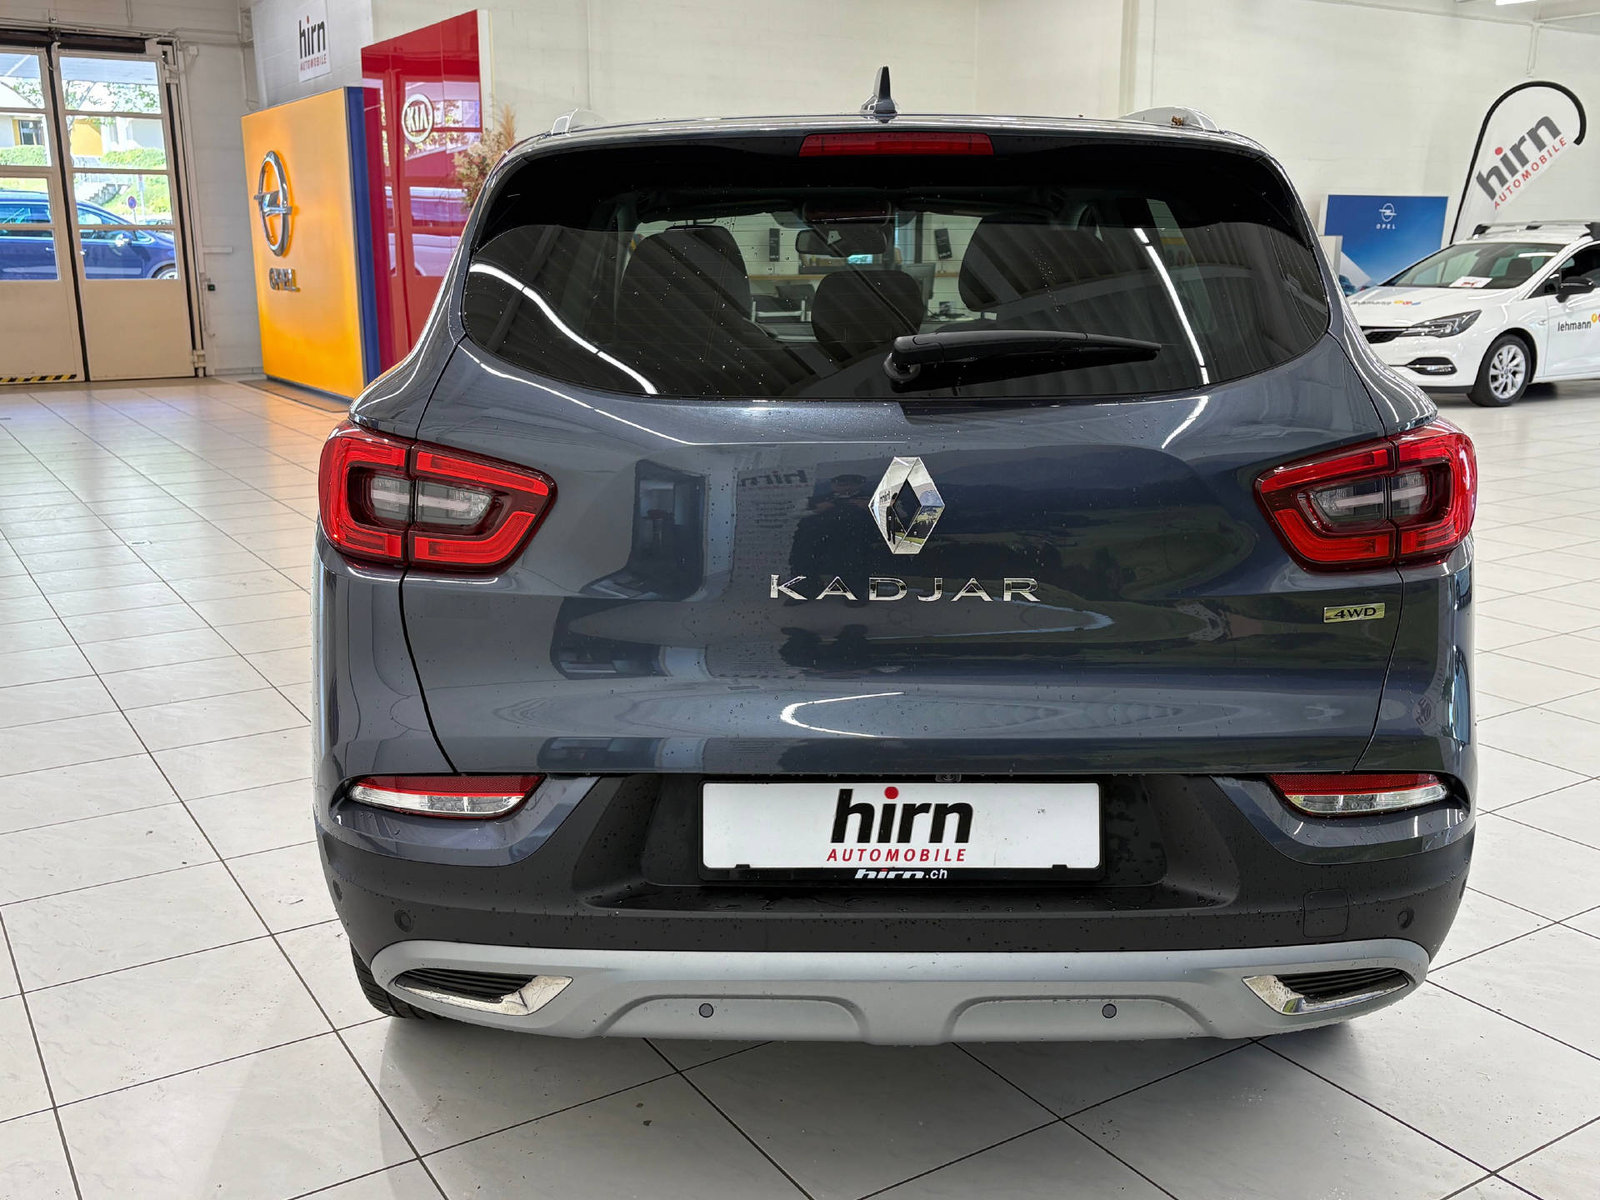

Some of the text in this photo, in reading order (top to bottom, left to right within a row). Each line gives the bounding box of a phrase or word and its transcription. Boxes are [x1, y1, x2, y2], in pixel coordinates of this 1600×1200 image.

[299, 15, 326, 59] hirn
[406, 103, 429, 132] KIA
[1476, 116, 1562, 201] hirn
[1494, 137, 1567, 210] AUTOMOBILE
[1557, 320, 1592, 332] lehmann
[770, 574, 1041, 602] KADJAR
[1335, 607, 1377, 619] 4WD
[830, 786, 974, 844] hirn
[826, 848, 967, 862] AUTOMOBILE
[854, 868, 948, 880] hirn.ch
